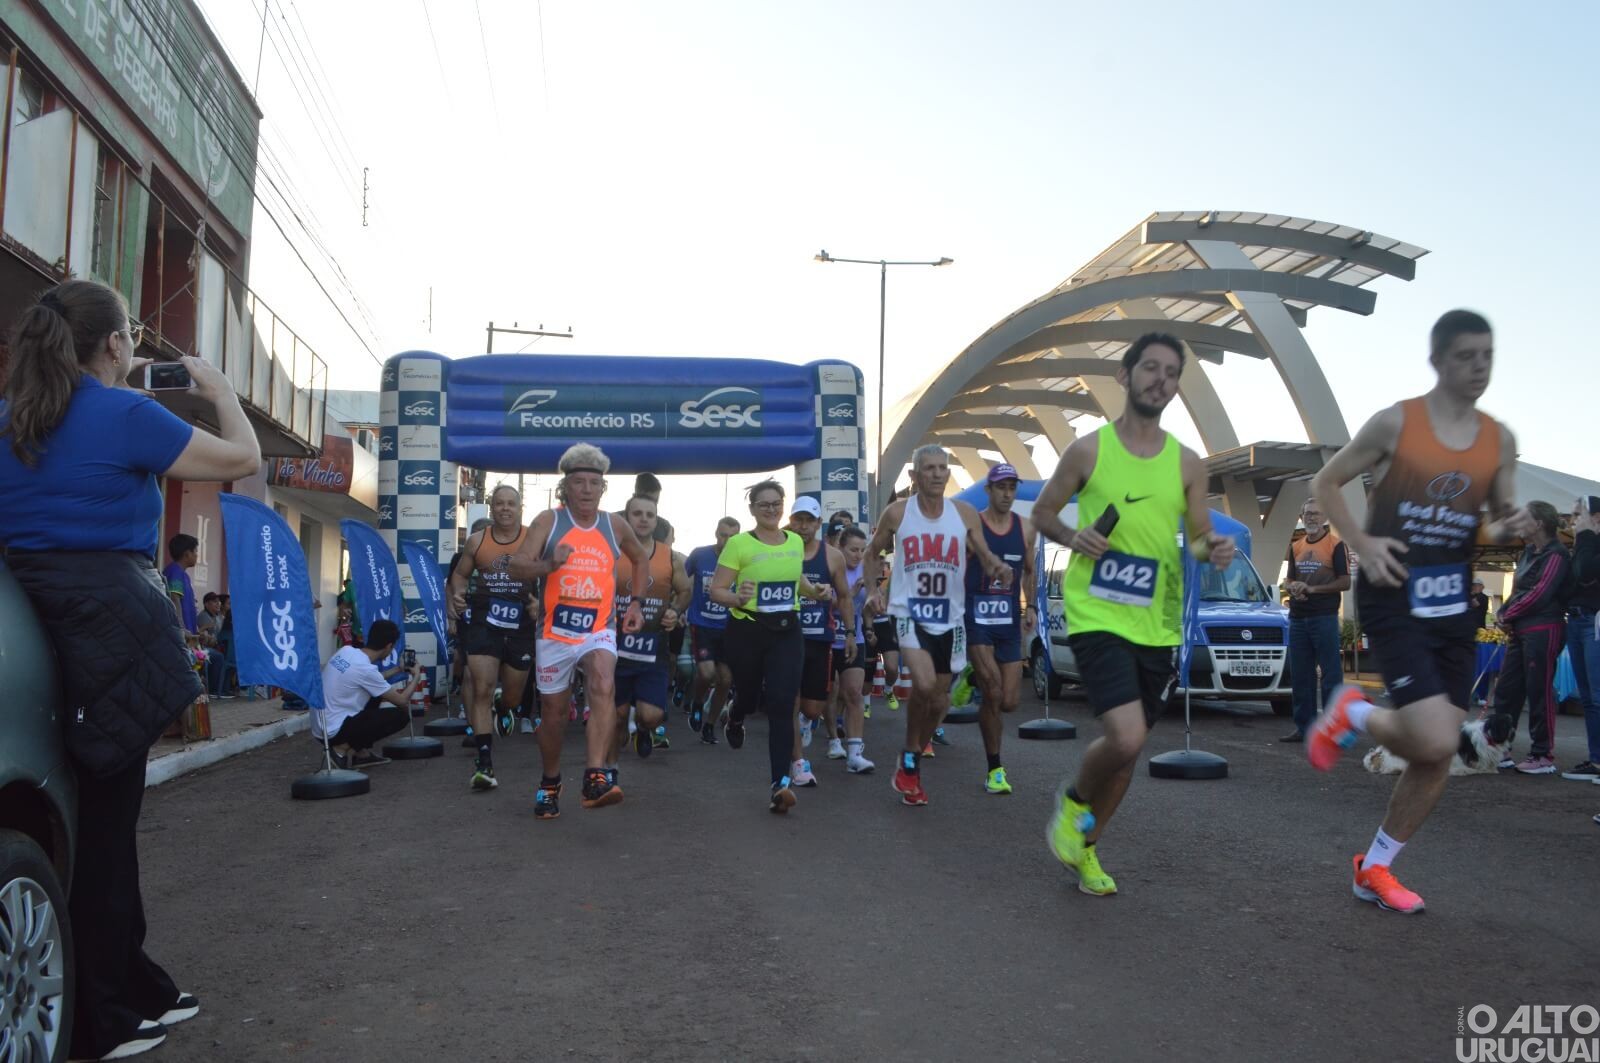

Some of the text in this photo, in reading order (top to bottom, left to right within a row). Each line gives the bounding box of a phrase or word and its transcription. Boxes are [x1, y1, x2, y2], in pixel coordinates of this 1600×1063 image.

[84, 0, 108, 53] DE
[404, 404, 435, 416] Sesc
[678, 396, 761, 428] Sesc
[827, 406, 854, 418] Sesc
[520, 412, 655, 428] Fecomércio RS
[404, 473, 435, 486] Sesc
[827, 471, 854, 482] Sesc
[261, 525, 276, 590] Fecomércio
[366, 544, 382, 600] Fecomércio
[1100, 558, 1153, 589] 042
[761, 586, 793, 601] 049
[917, 572, 947, 597] 30
[1414, 573, 1463, 599] 003
[491, 603, 519, 619] 019
[912, 603, 944, 618] 101
[977, 600, 1009, 614] 070
[559, 610, 594, 629] 150
[269, 601, 299, 672] Sesc
[624, 634, 655, 652] 011
